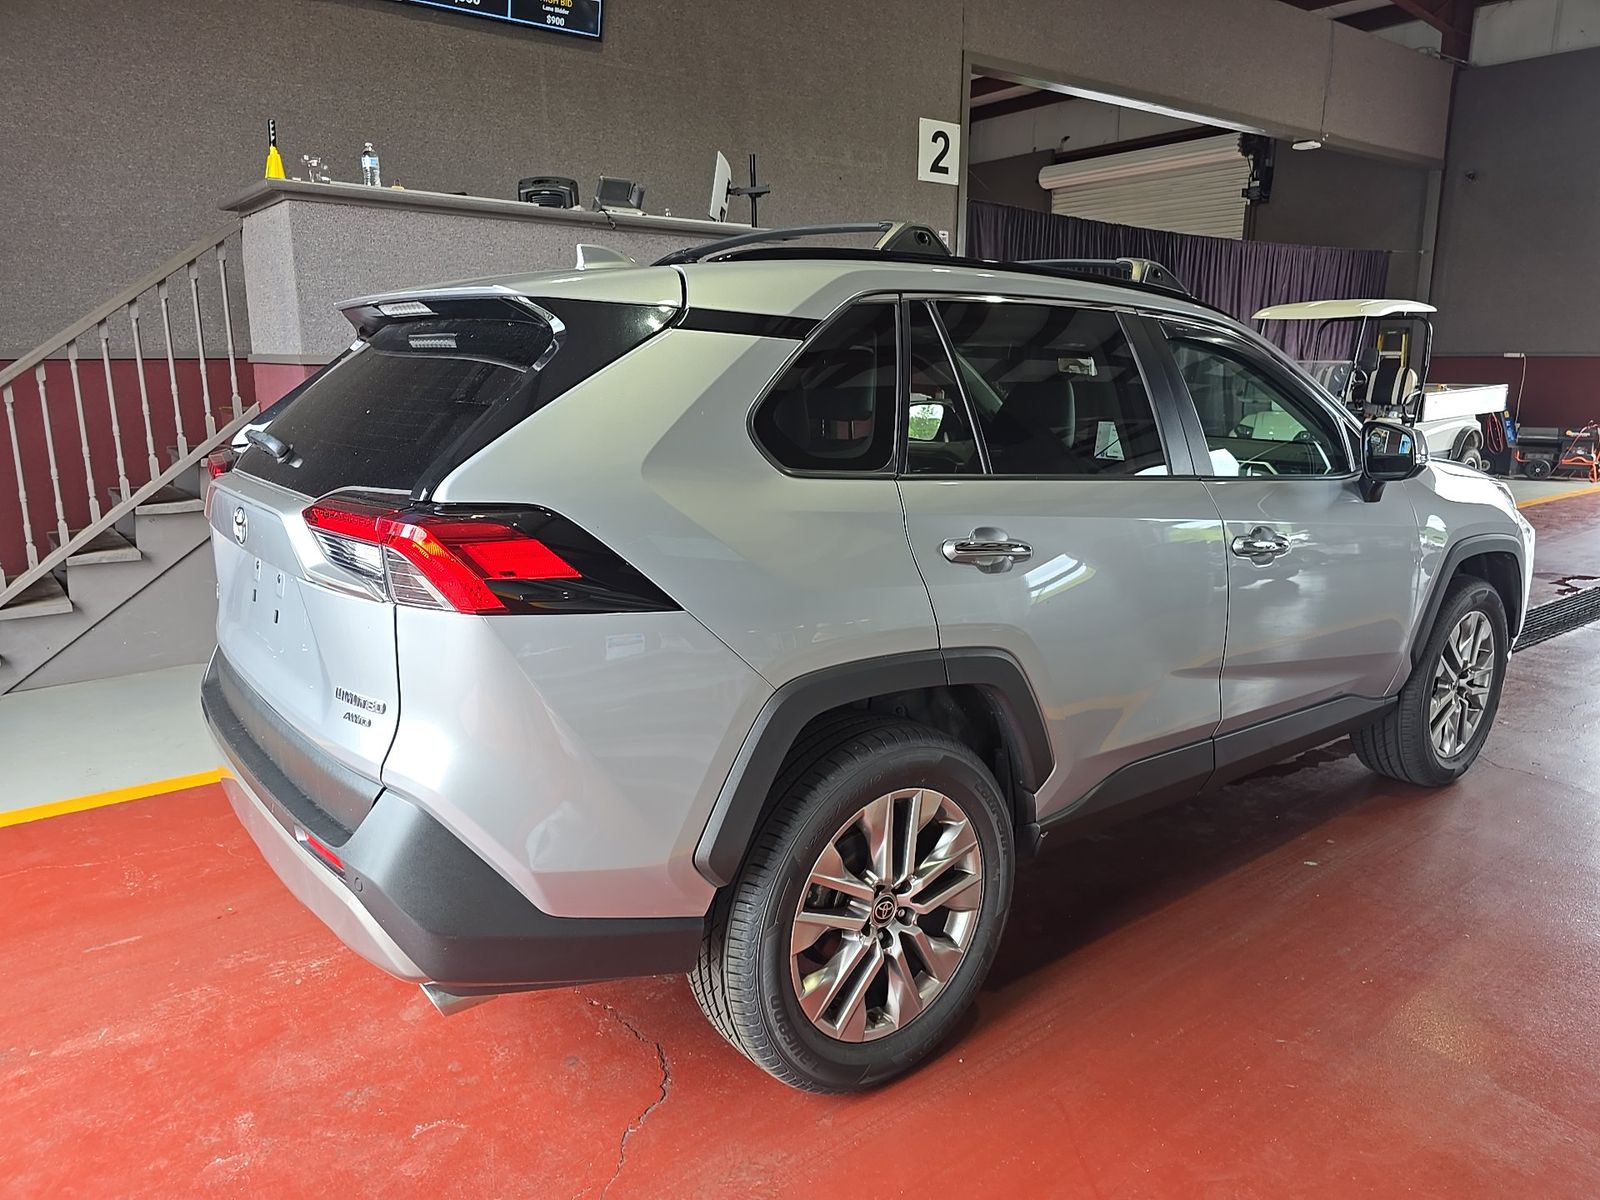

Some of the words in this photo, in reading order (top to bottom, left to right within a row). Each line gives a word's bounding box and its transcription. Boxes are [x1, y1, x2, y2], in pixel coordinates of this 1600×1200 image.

[546, 14, 565, 26] $900
[930, 130, 950, 175] 2
[335, 687, 387, 715] LIMITED
[342, 711, 372, 727] AWD
